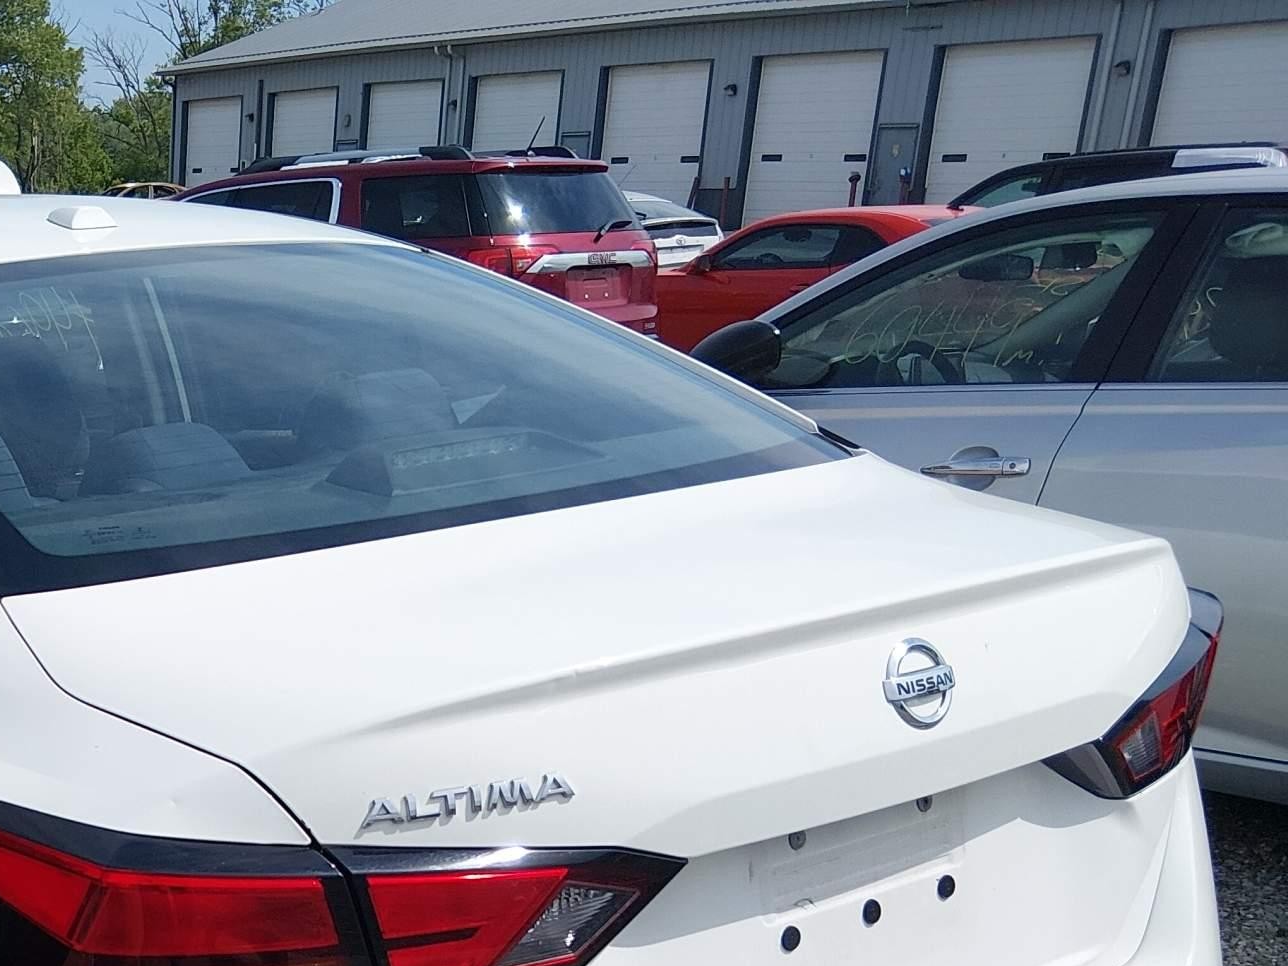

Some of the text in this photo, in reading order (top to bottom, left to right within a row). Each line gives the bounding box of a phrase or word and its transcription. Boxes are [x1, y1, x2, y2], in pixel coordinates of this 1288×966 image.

[588, 253, 616, 264] GMC
[896, 671, 953, 695] NISSAN
[361, 773, 575, 829] ALTIMA
